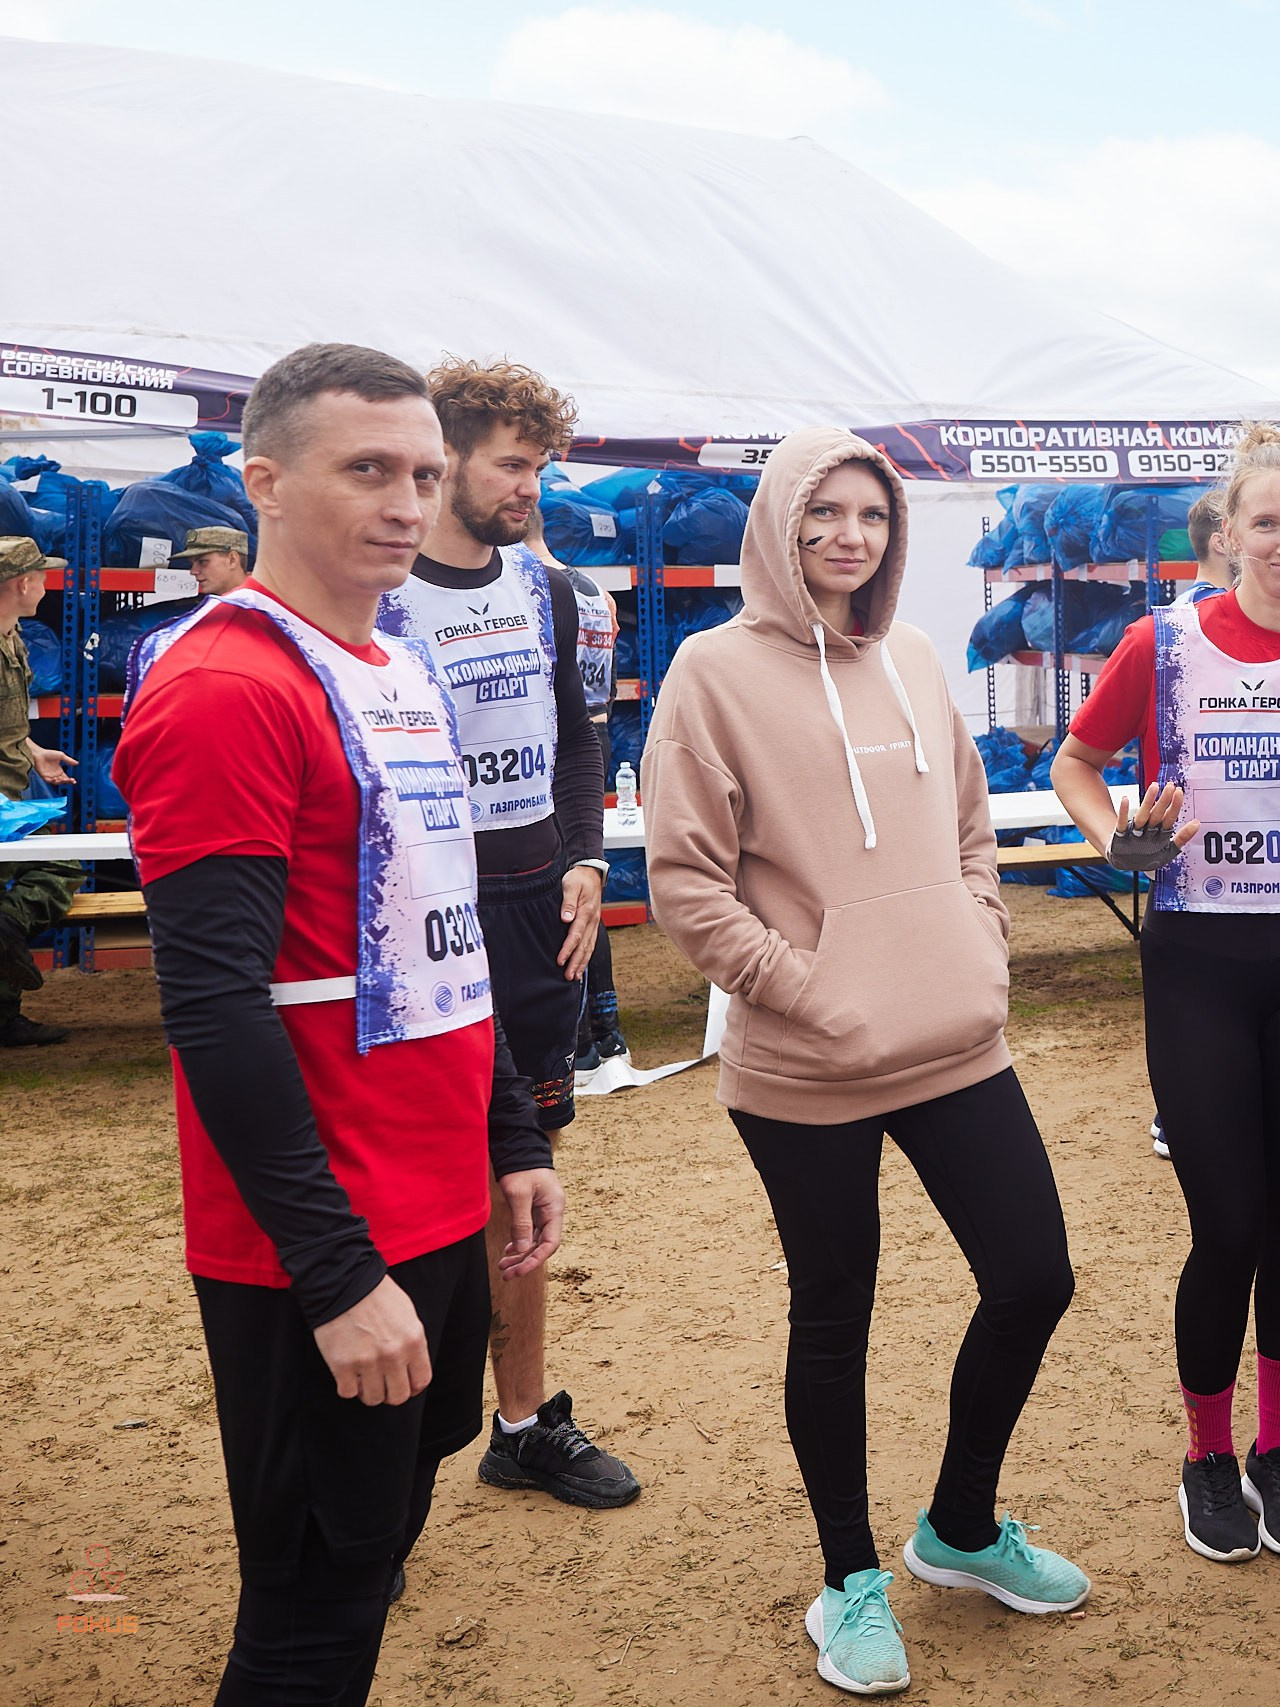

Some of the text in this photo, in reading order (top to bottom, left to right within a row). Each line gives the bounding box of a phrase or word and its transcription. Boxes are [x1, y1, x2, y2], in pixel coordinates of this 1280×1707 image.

[1, 350, 178, 380] ВСЕРОССИЙСКИЕ
[3, 361, 174, 390] СОРЕВНОВАНИЯ
[41, 388, 137, 418] 1-100
[940, 426, 1163, 447] КОРПОРАТИВНАЯ
[981, 455, 1108, 473] 5501-5550
[435, 614, 528, 642] ГОНКА ГЕРОЕВ
[447, 648, 540, 685] КОМАНДНЫЙ
[479, 677, 525, 701] СТАРТ
[1199, 697, 1247, 709] ГОНКА
[853, 744, 887, 754] UTDOOR
[462, 743, 546, 788] 03204
[1228, 759, 1279, 779] СТАРТ
[421, 799, 458, 827] СТАРТ
[489, 793, 547, 815] ГАЗПРОМБАНК
[425, 902, 485, 962] 0320
